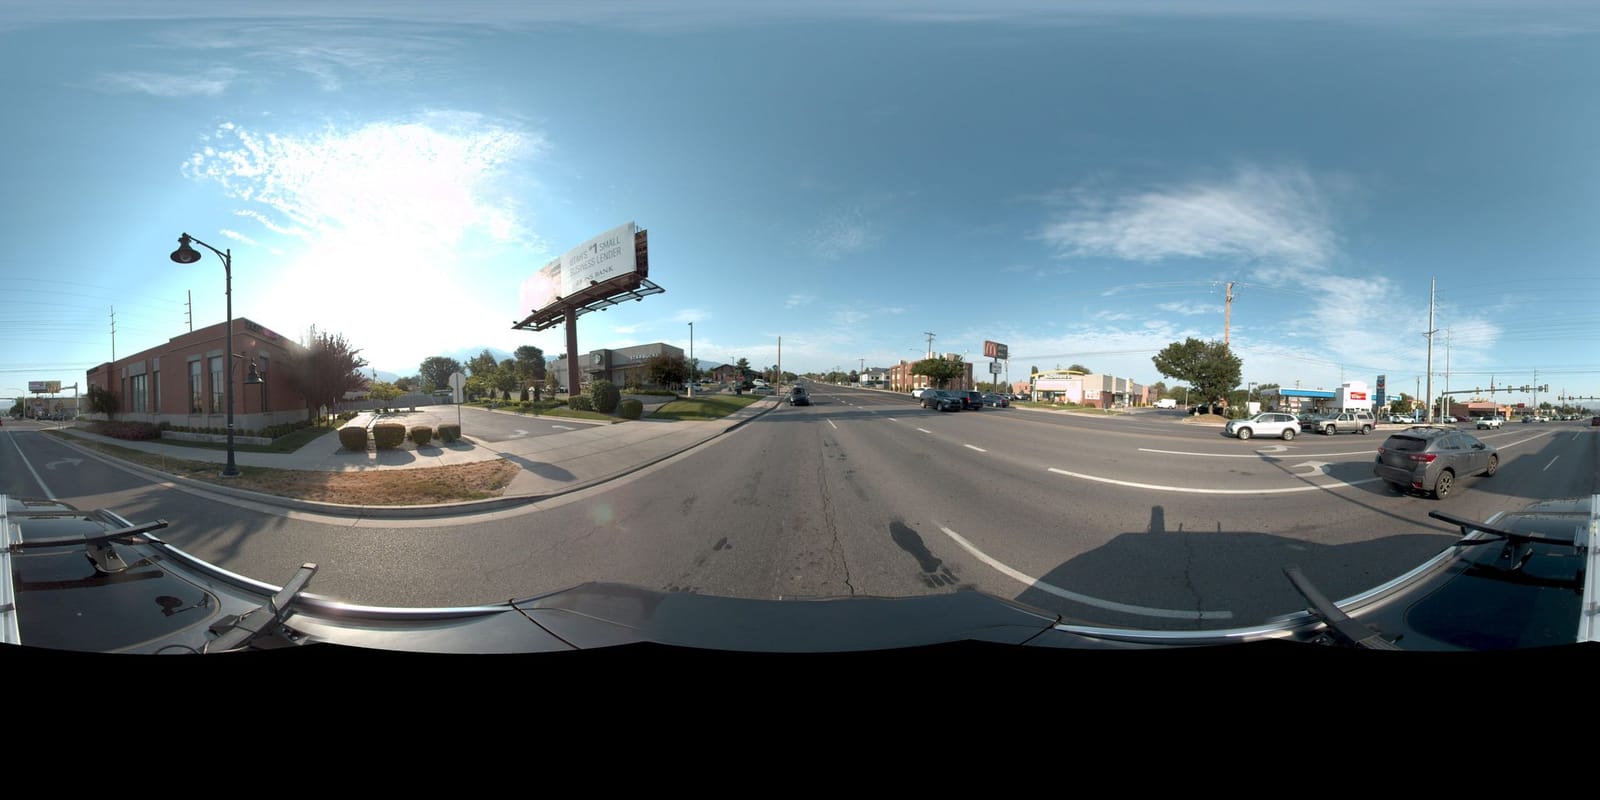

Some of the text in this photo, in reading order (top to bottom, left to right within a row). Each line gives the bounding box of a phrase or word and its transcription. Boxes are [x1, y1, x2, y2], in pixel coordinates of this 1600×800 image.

[599, 235, 621, 251] SMALL
[570, 247, 622, 276] BUSINESS LENDER
[594, 265, 614, 277] BANK
